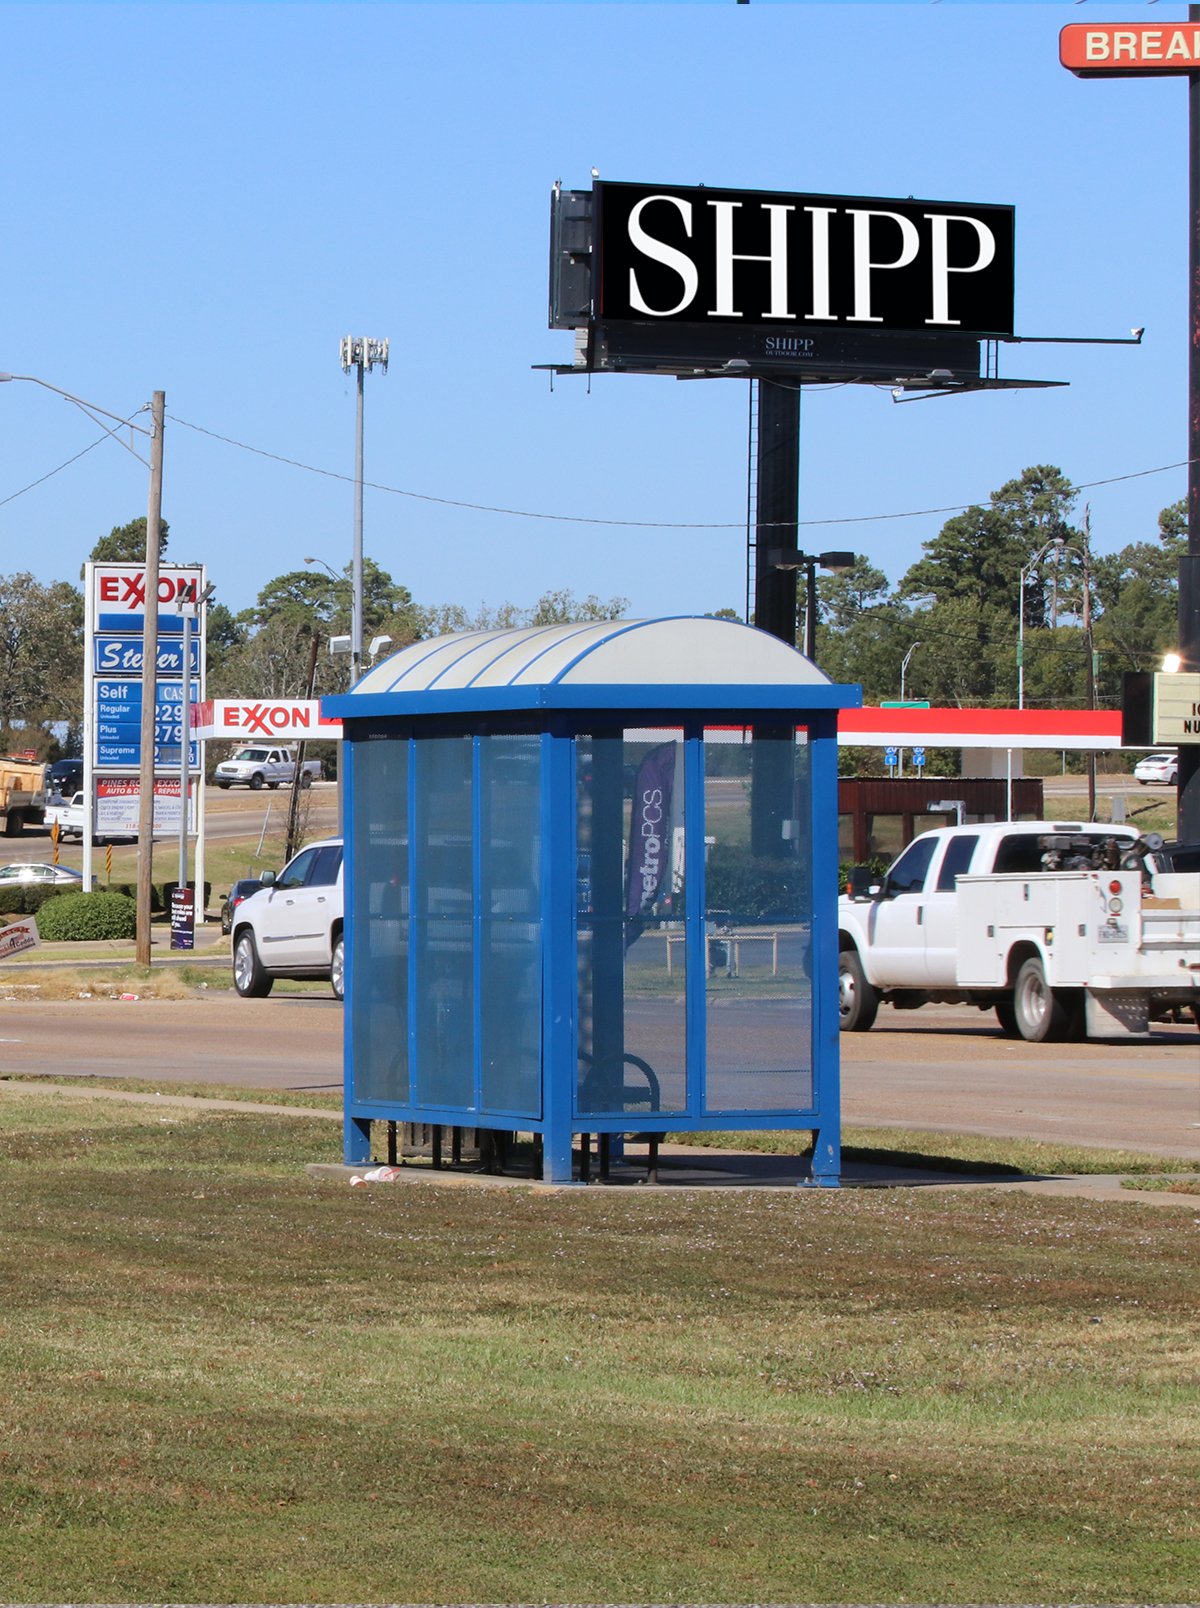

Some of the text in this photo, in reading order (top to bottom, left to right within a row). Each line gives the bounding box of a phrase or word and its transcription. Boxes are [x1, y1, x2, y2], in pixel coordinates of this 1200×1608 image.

[627, 195, 996, 325] SHIPP
[765, 337, 814, 350] SHIPP
[100, 686, 128, 698] Self
[100, 704, 130, 714] Regular
[223, 703, 310, 736] EXXON
[100, 725, 117, 733] Plus
[100, 746, 135, 756] Supreme
[157, 780, 181, 788] EXXO
